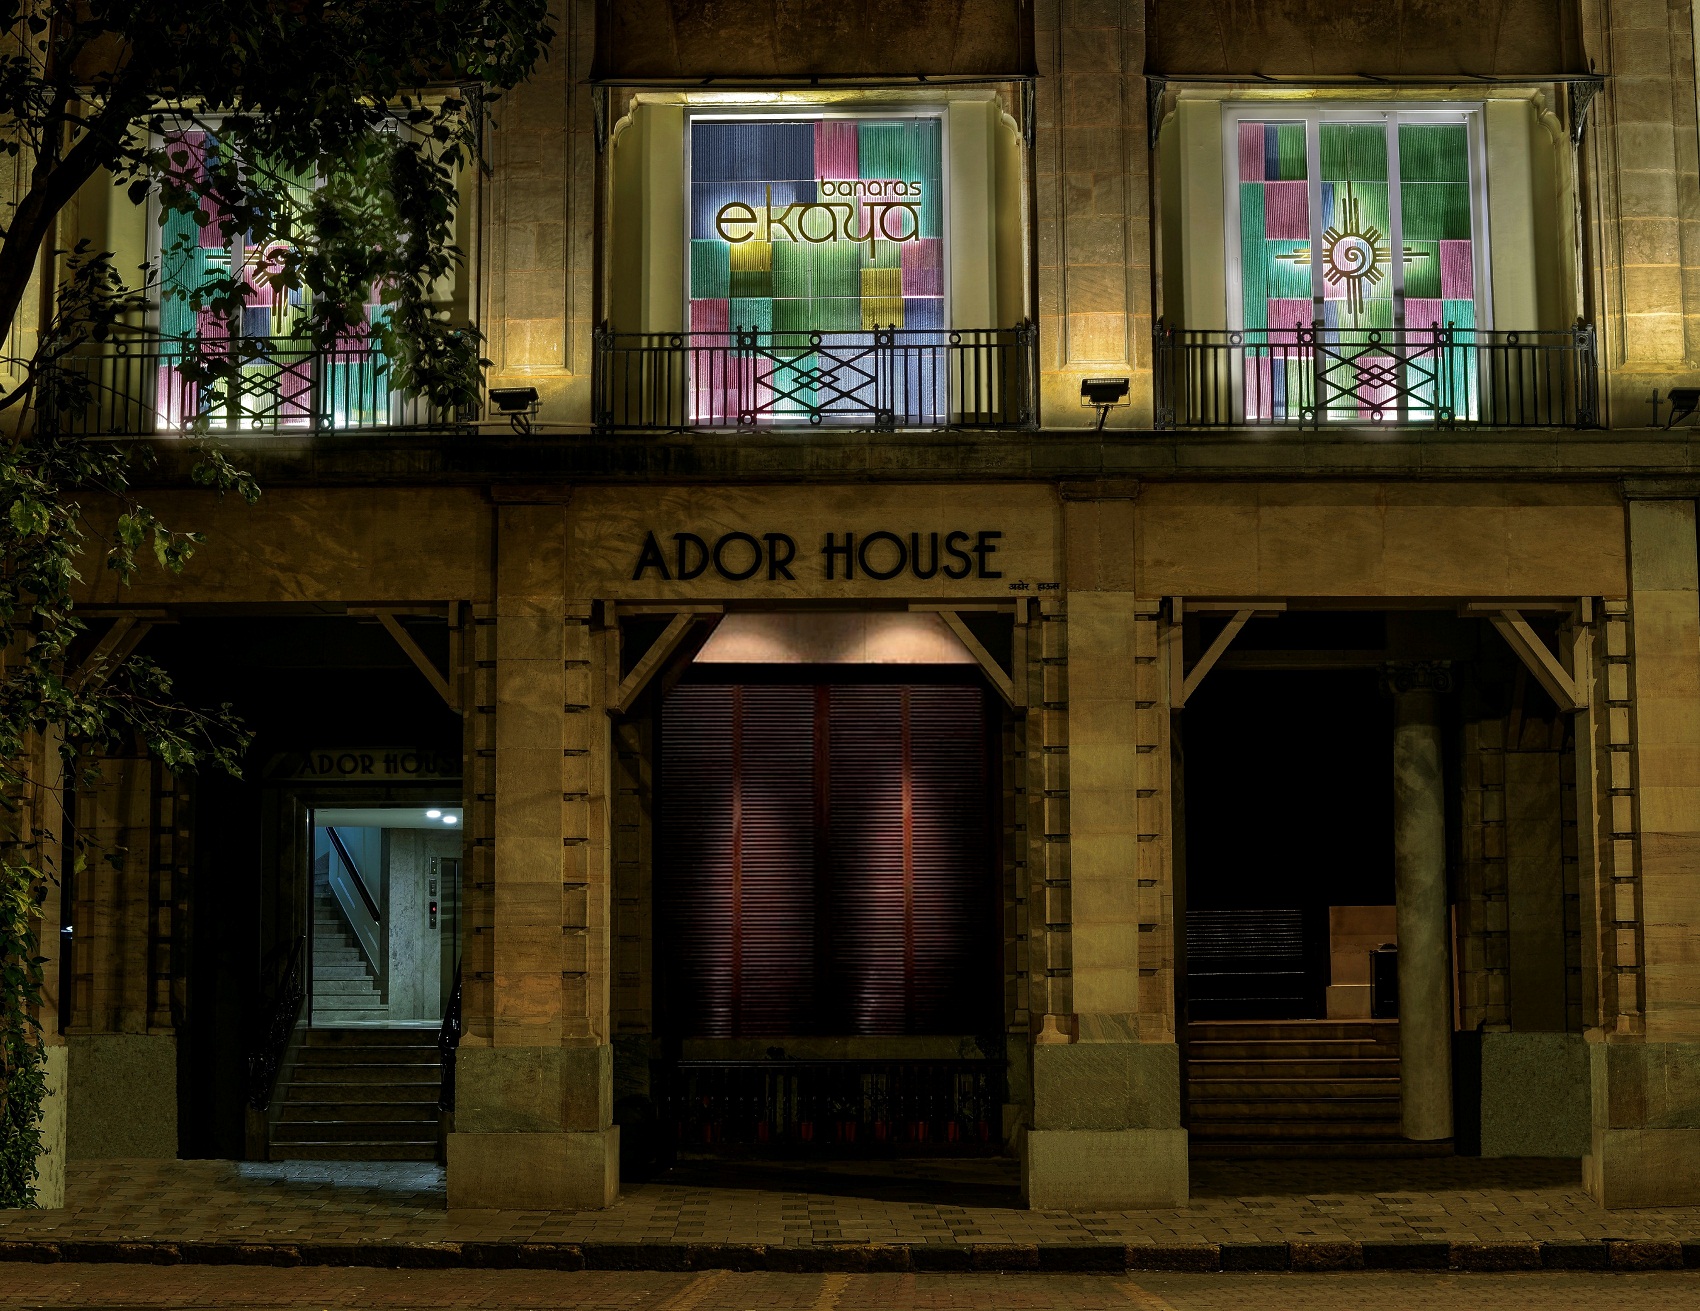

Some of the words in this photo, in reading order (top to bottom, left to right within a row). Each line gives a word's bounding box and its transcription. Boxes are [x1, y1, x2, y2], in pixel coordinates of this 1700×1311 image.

[820, 175, 922, 197] banaras
[716, 184, 922, 260] ekaya
[632, 530, 797, 580] ADOR
[821, 530, 1002, 579] HOUSE
[299, 753, 375, 775] ADOR
